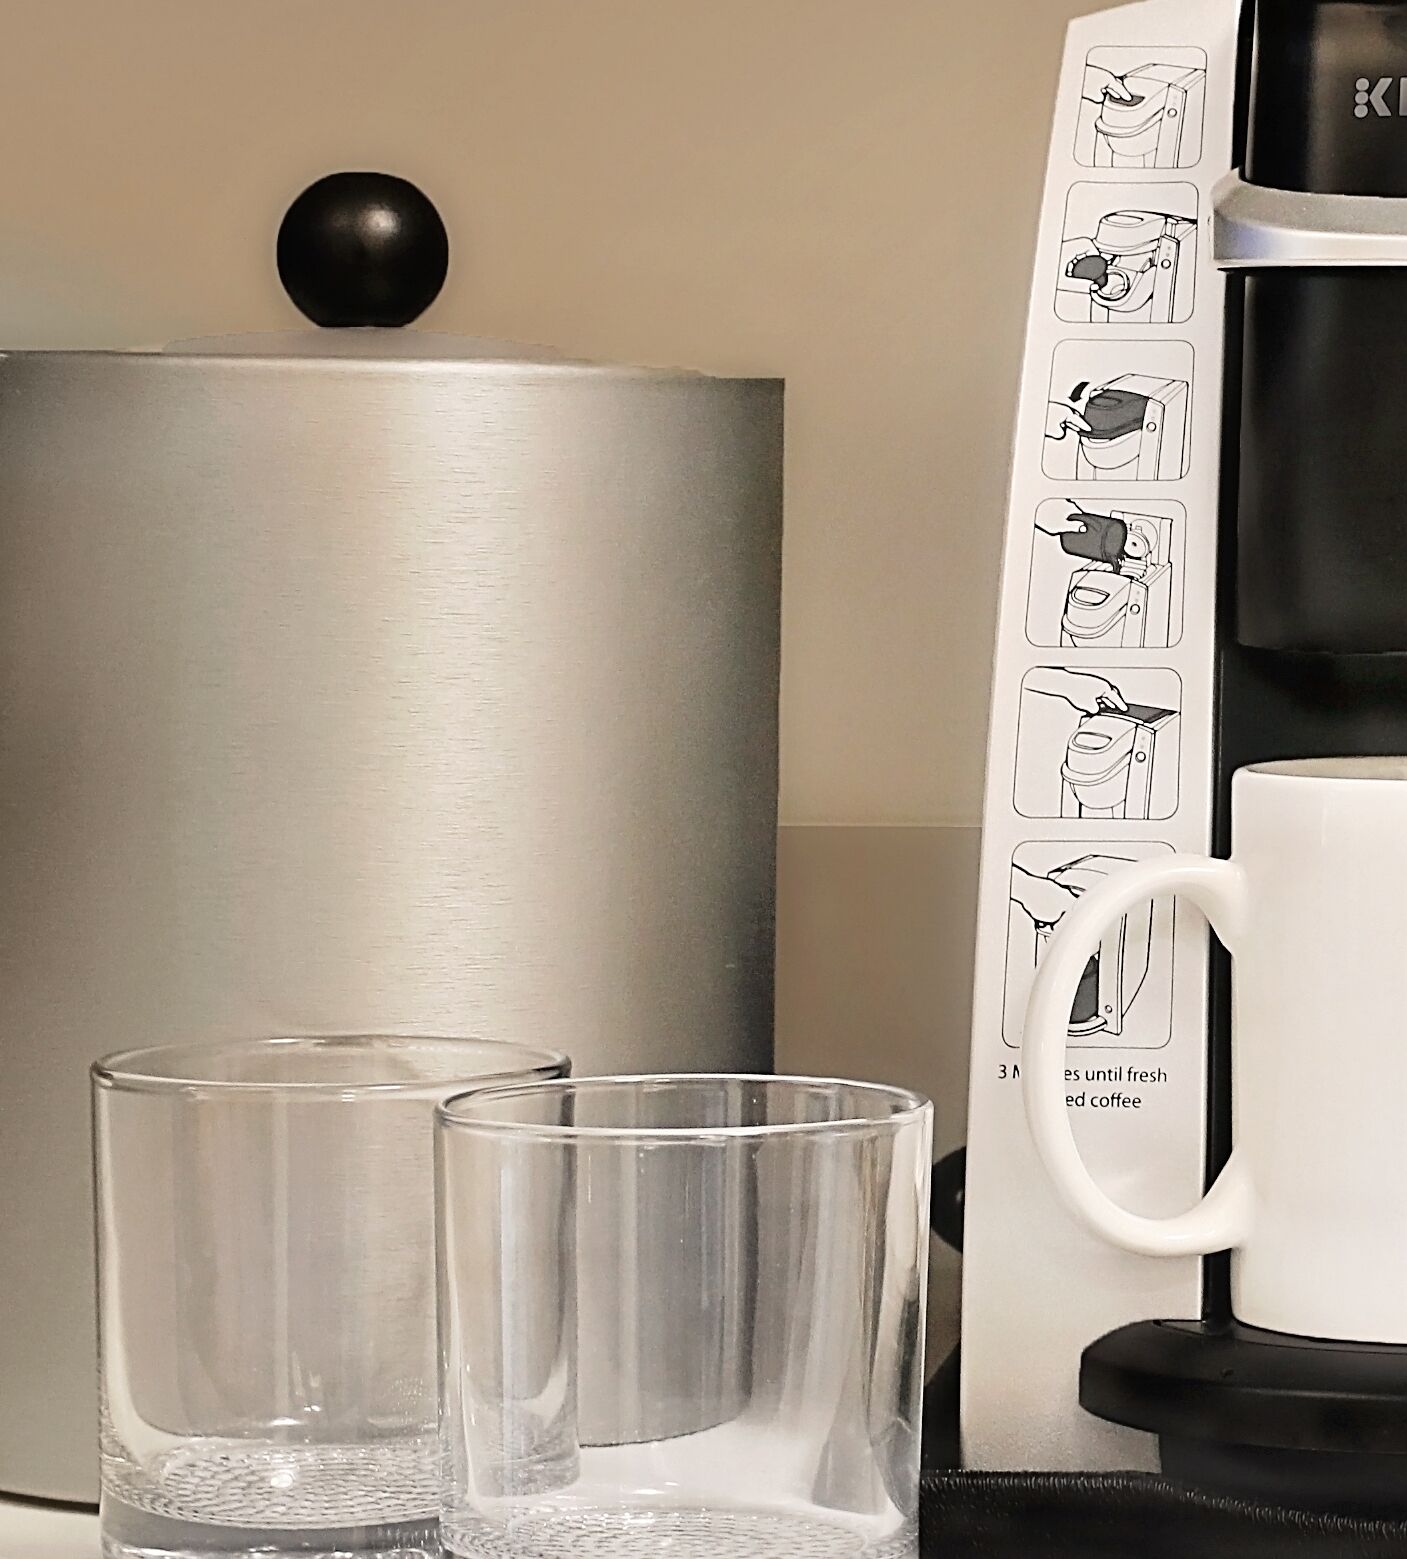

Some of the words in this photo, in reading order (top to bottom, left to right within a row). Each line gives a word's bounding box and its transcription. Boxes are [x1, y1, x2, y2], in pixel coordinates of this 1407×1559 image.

[997, 1064, 1007, 1079] 3
[1085, 1066, 1123, 1082] until
[1127, 1066, 1168, 1083] fresh
[1090, 1092, 1142, 1109] coffee
